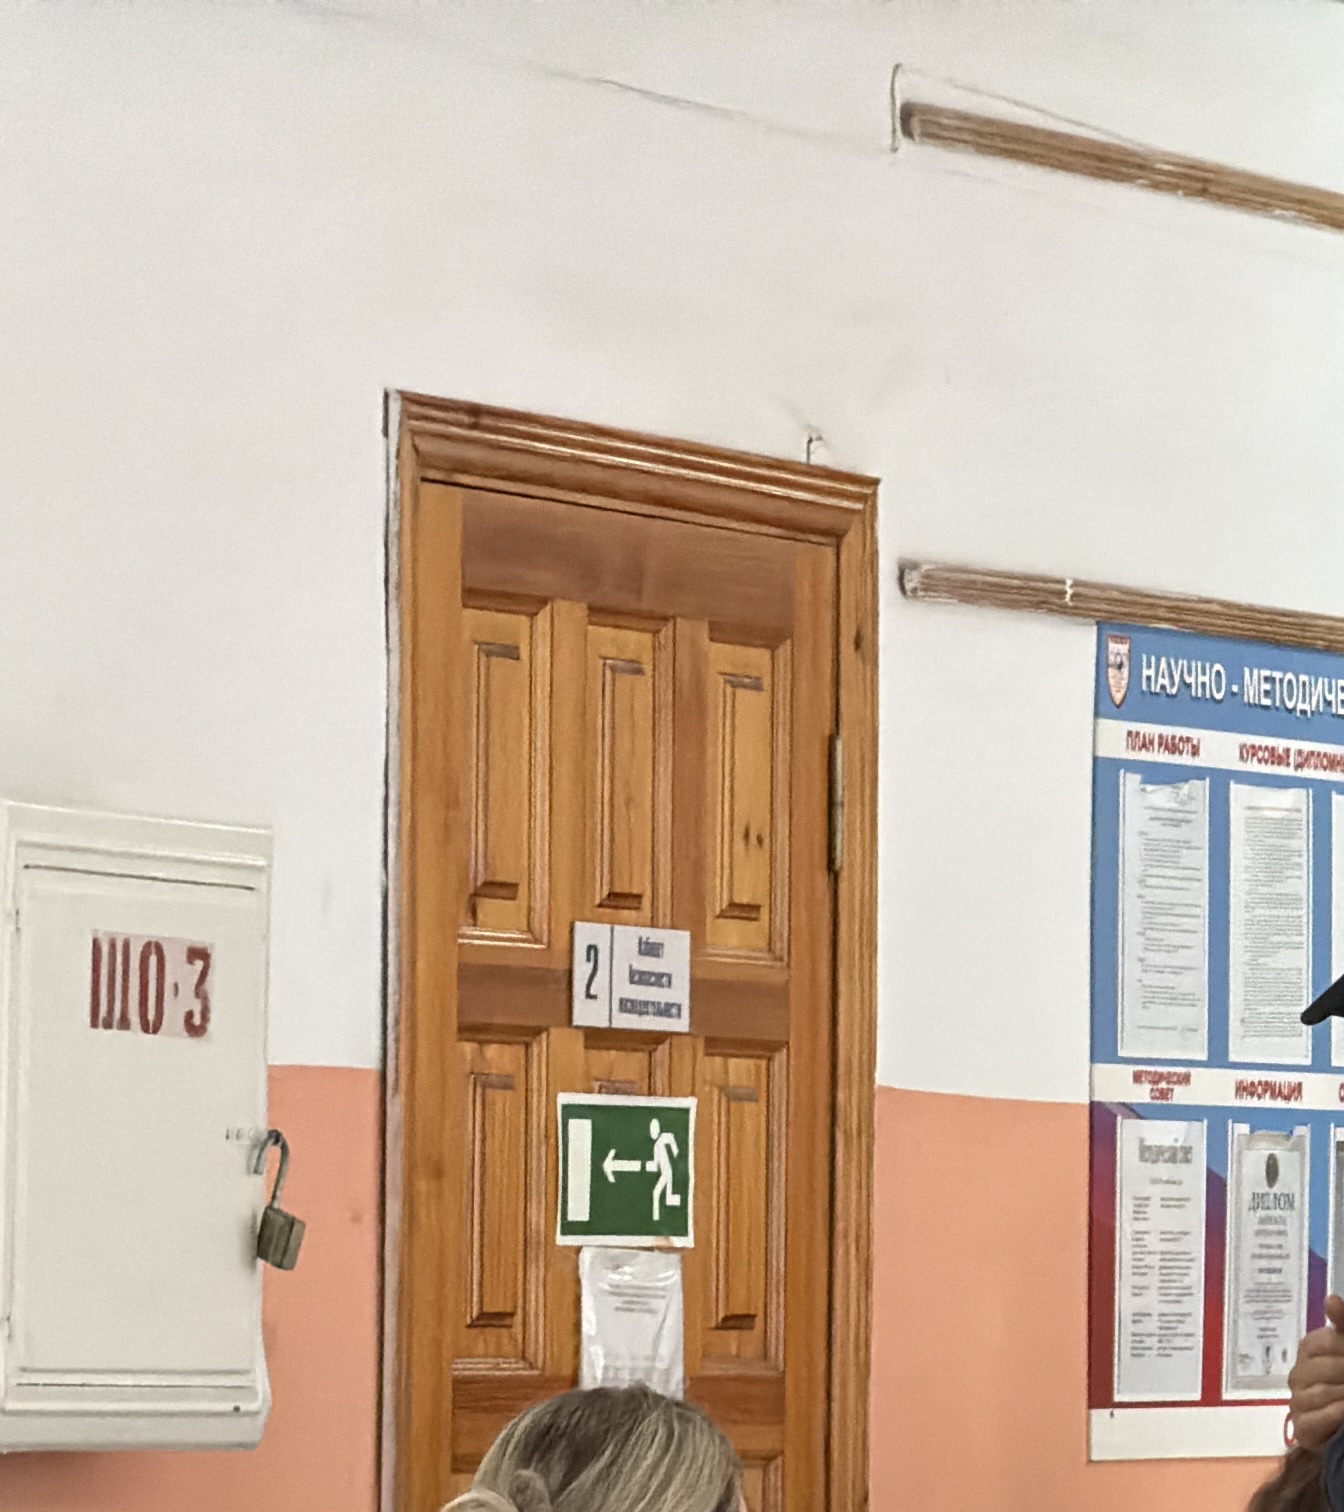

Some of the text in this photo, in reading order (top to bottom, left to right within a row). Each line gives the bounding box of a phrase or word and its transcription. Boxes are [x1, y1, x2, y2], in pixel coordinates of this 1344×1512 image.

[1141, 654, 1226, 700] НАУЧНО
[1126, 730, 1201, 758] ПЛАН РАБОТЫ
[1238, 743, 1292, 768] КУРСОВЫЕ
[585, 944, 599, 1000] 2
[1248, 1192, 1295, 1214] ДИПЛОМ
